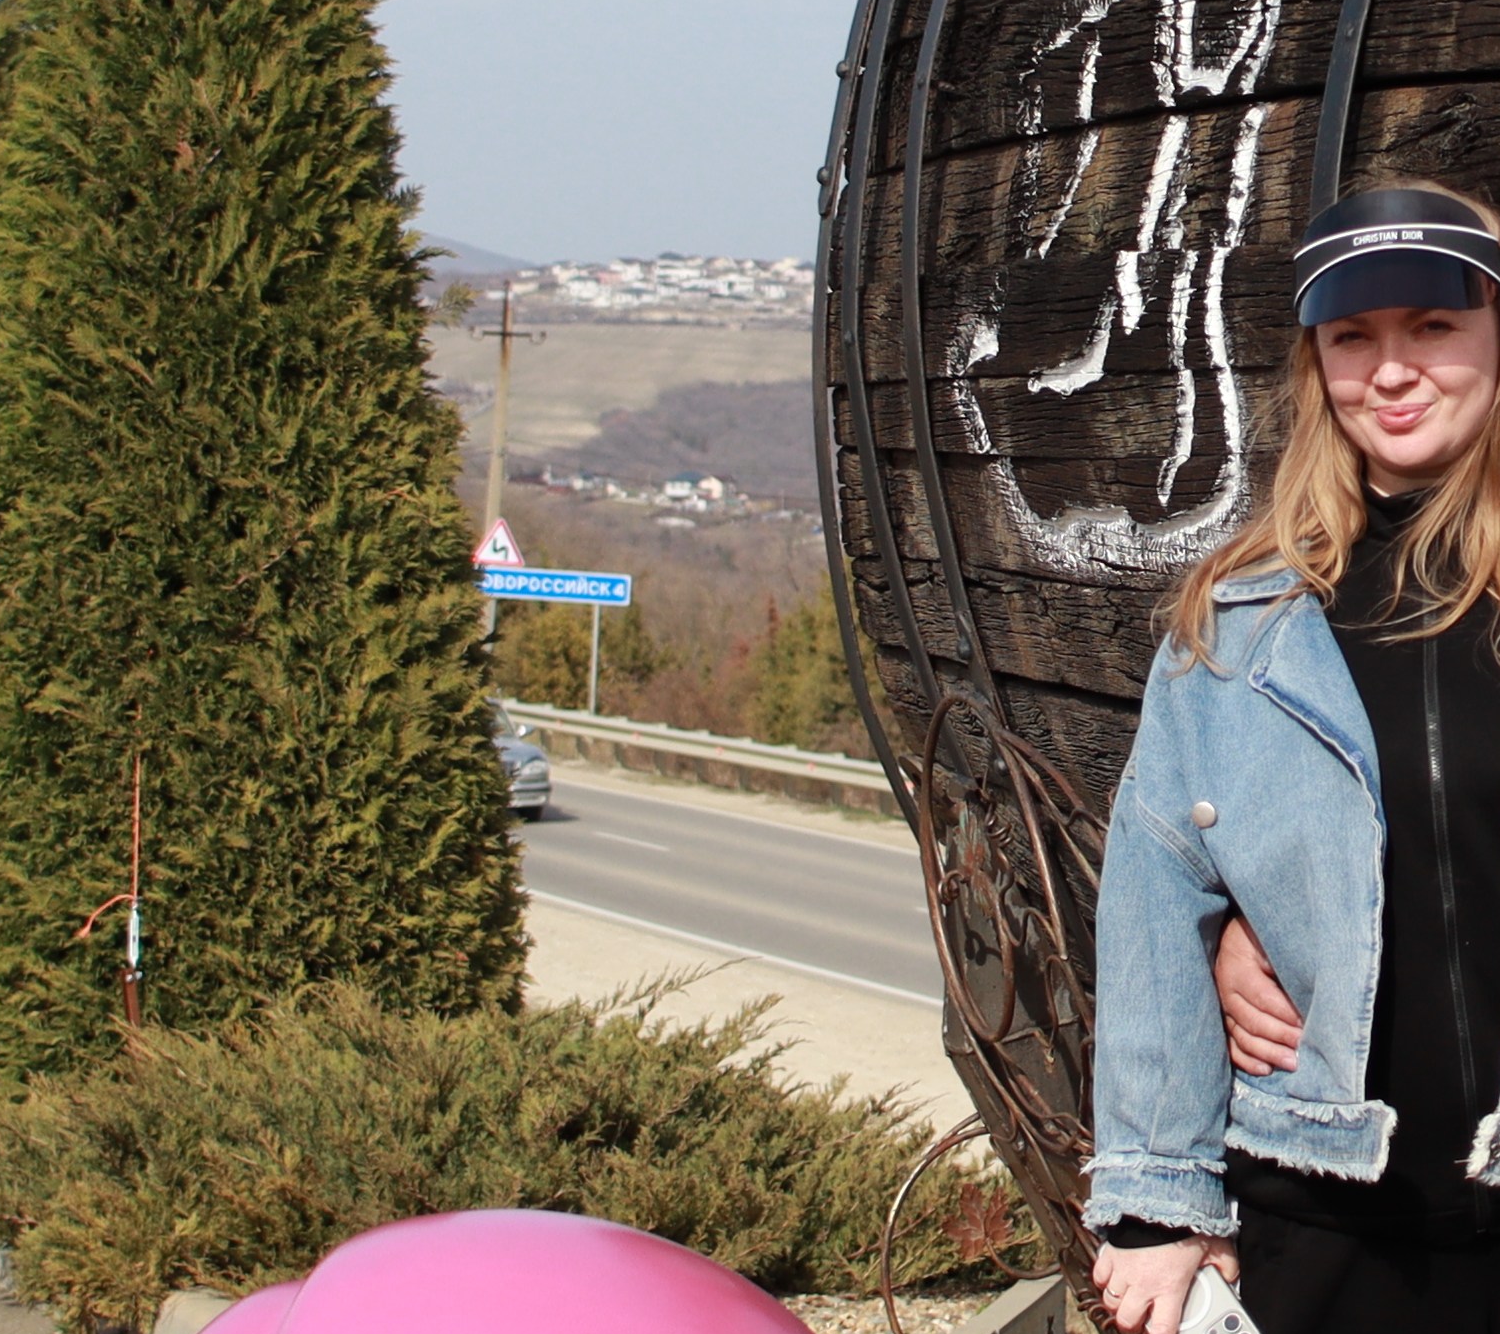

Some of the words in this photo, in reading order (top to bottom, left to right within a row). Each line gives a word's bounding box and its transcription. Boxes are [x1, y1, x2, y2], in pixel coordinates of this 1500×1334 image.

[1353, 231, 1398, 246] CHRISTIAN
[1402, 230, 1423, 240] DIOR
[482, 573, 610, 597] ОВОРОССИЙСК
[612, 583, 625, 597] 4
